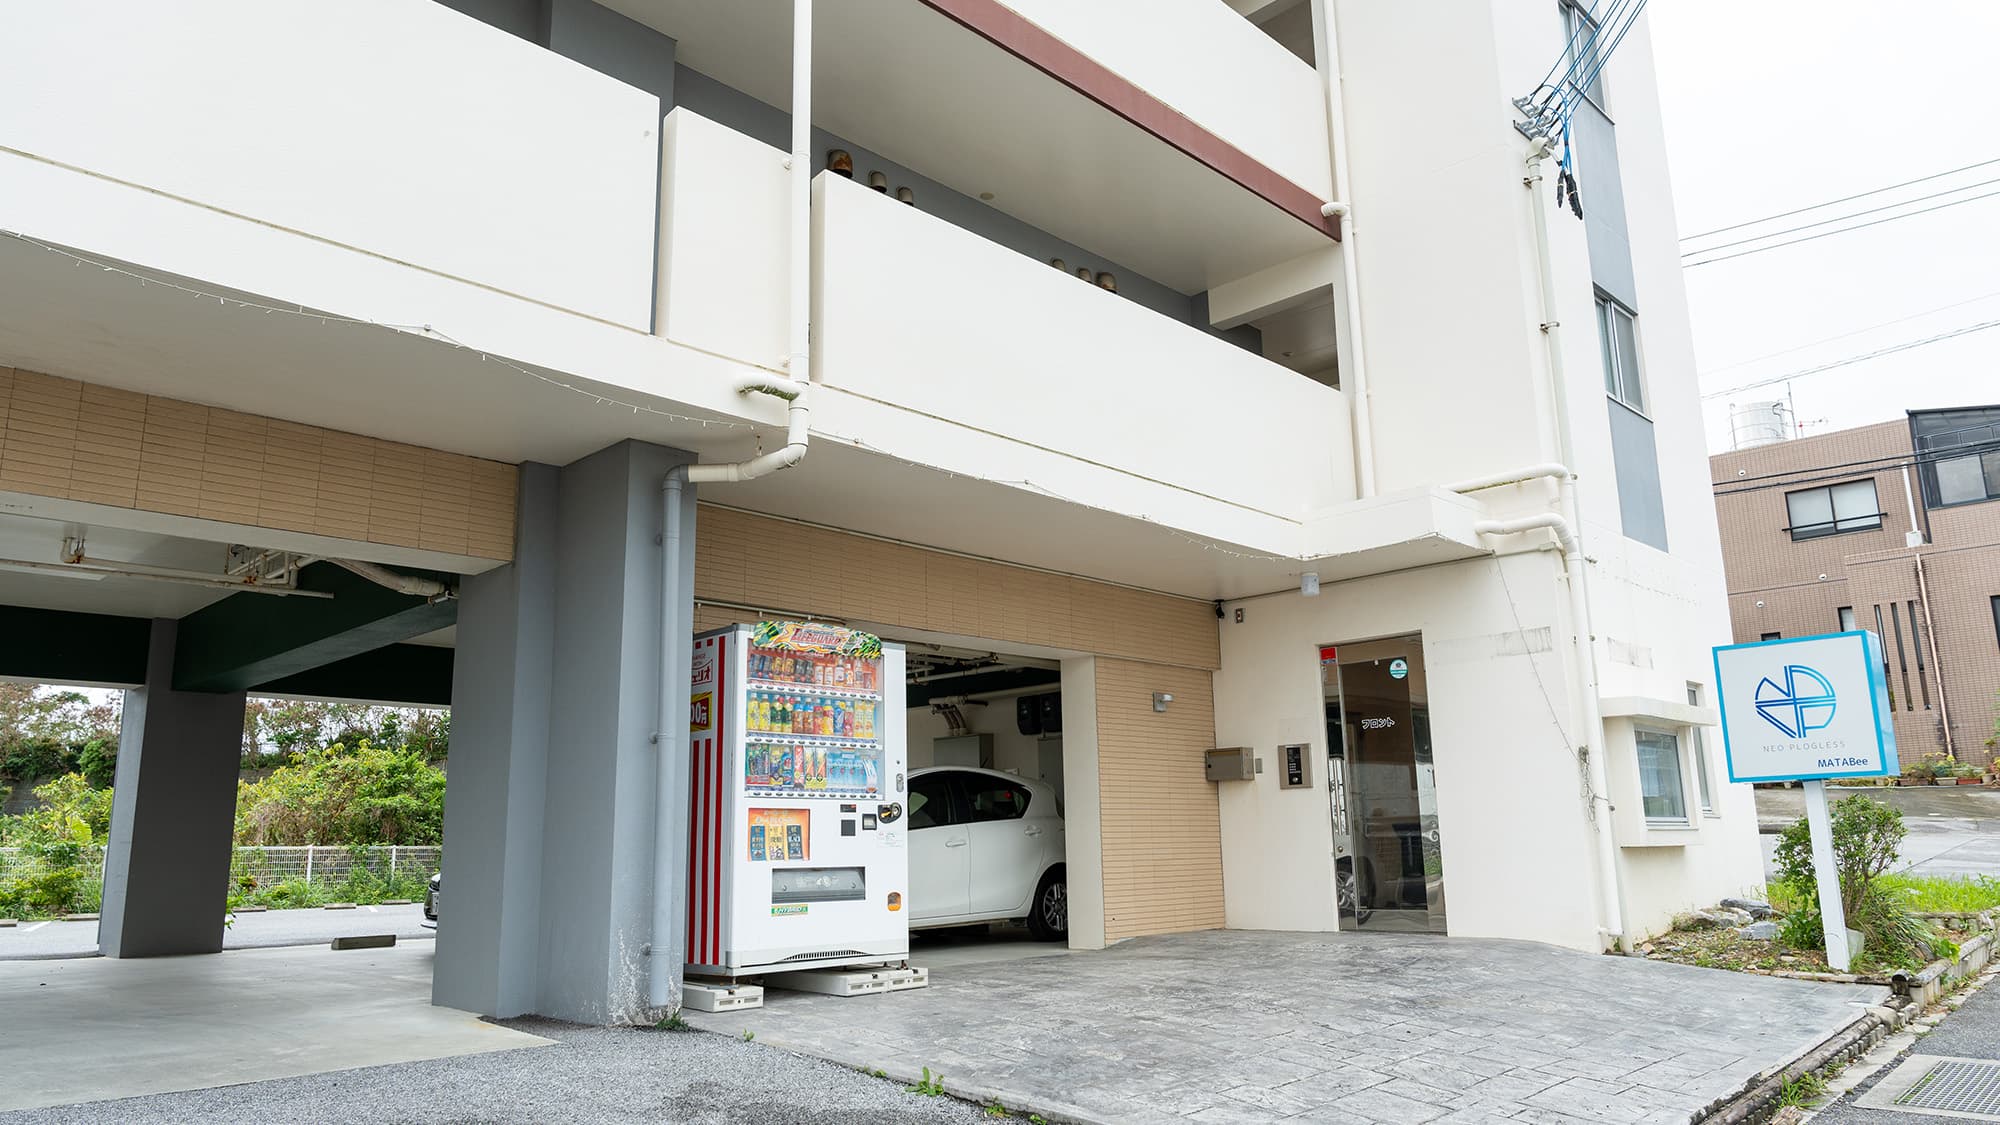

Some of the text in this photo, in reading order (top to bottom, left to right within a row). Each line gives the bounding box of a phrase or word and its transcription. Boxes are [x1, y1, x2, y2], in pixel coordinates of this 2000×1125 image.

[1361, 716, 1395, 730] フロント
[1762, 740, 1846, 752] NEO PLOGLESS
[1817, 757, 1868, 768] MATABee
